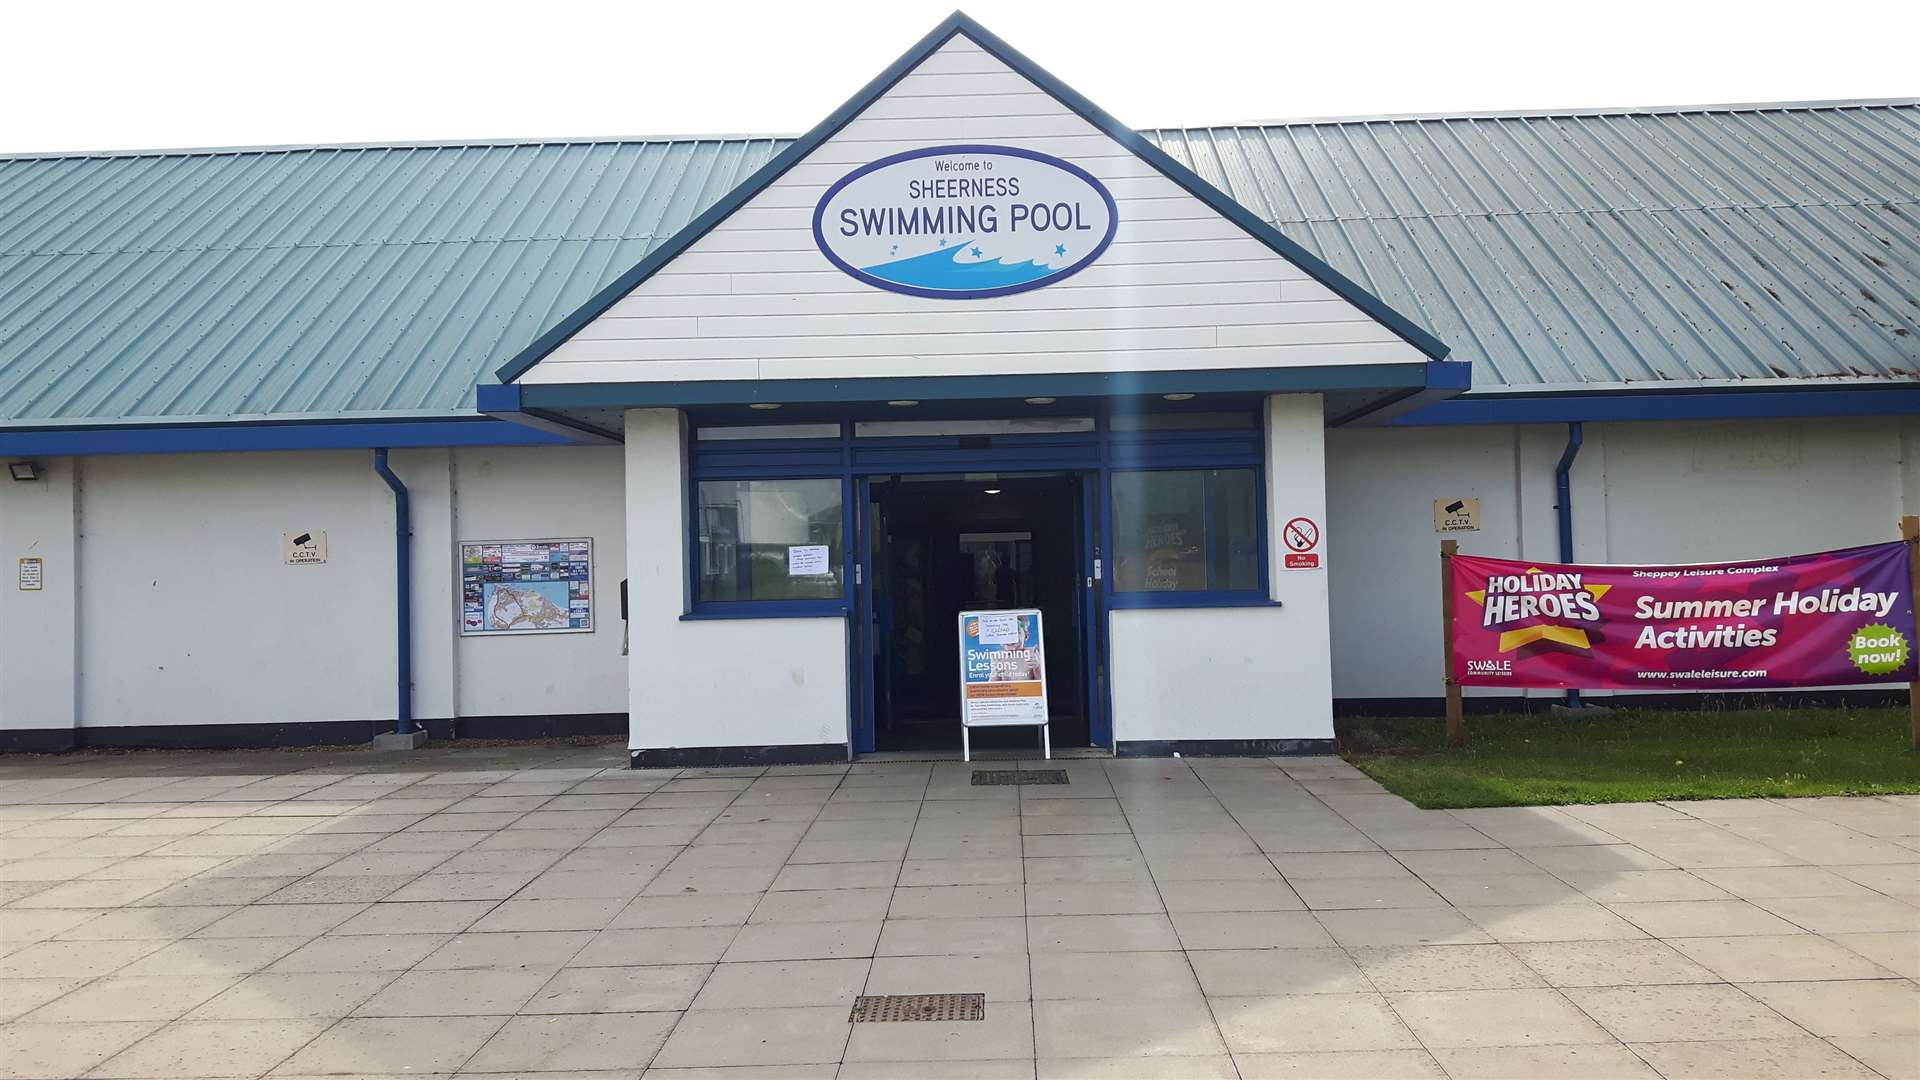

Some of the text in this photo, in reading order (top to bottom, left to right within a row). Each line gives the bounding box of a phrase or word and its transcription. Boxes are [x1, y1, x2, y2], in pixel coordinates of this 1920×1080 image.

[935, 160, 993, 172] Welcome to
[909, 177, 1020, 199] SHEERNESS
[840, 202, 1091, 236] SWIMMING POOL
[1633, 565, 1779, 579] Sheppey Leisure Complex
[1488, 573, 1582, 593] HOLIDAY
[1483, 591, 1600, 626] HEROES
[1634, 587, 1899, 619] Summer Holiday
[1634, 623, 1778, 649] Activities
[1855, 634, 1900, 649] Book
[968, 649, 1030, 661] Swimming
[1858, 649, 1901, 664] now!
[969, 661, 1017, 671] Lessons
[1637, 669, 1767, 679] www.swaleleisure.com
